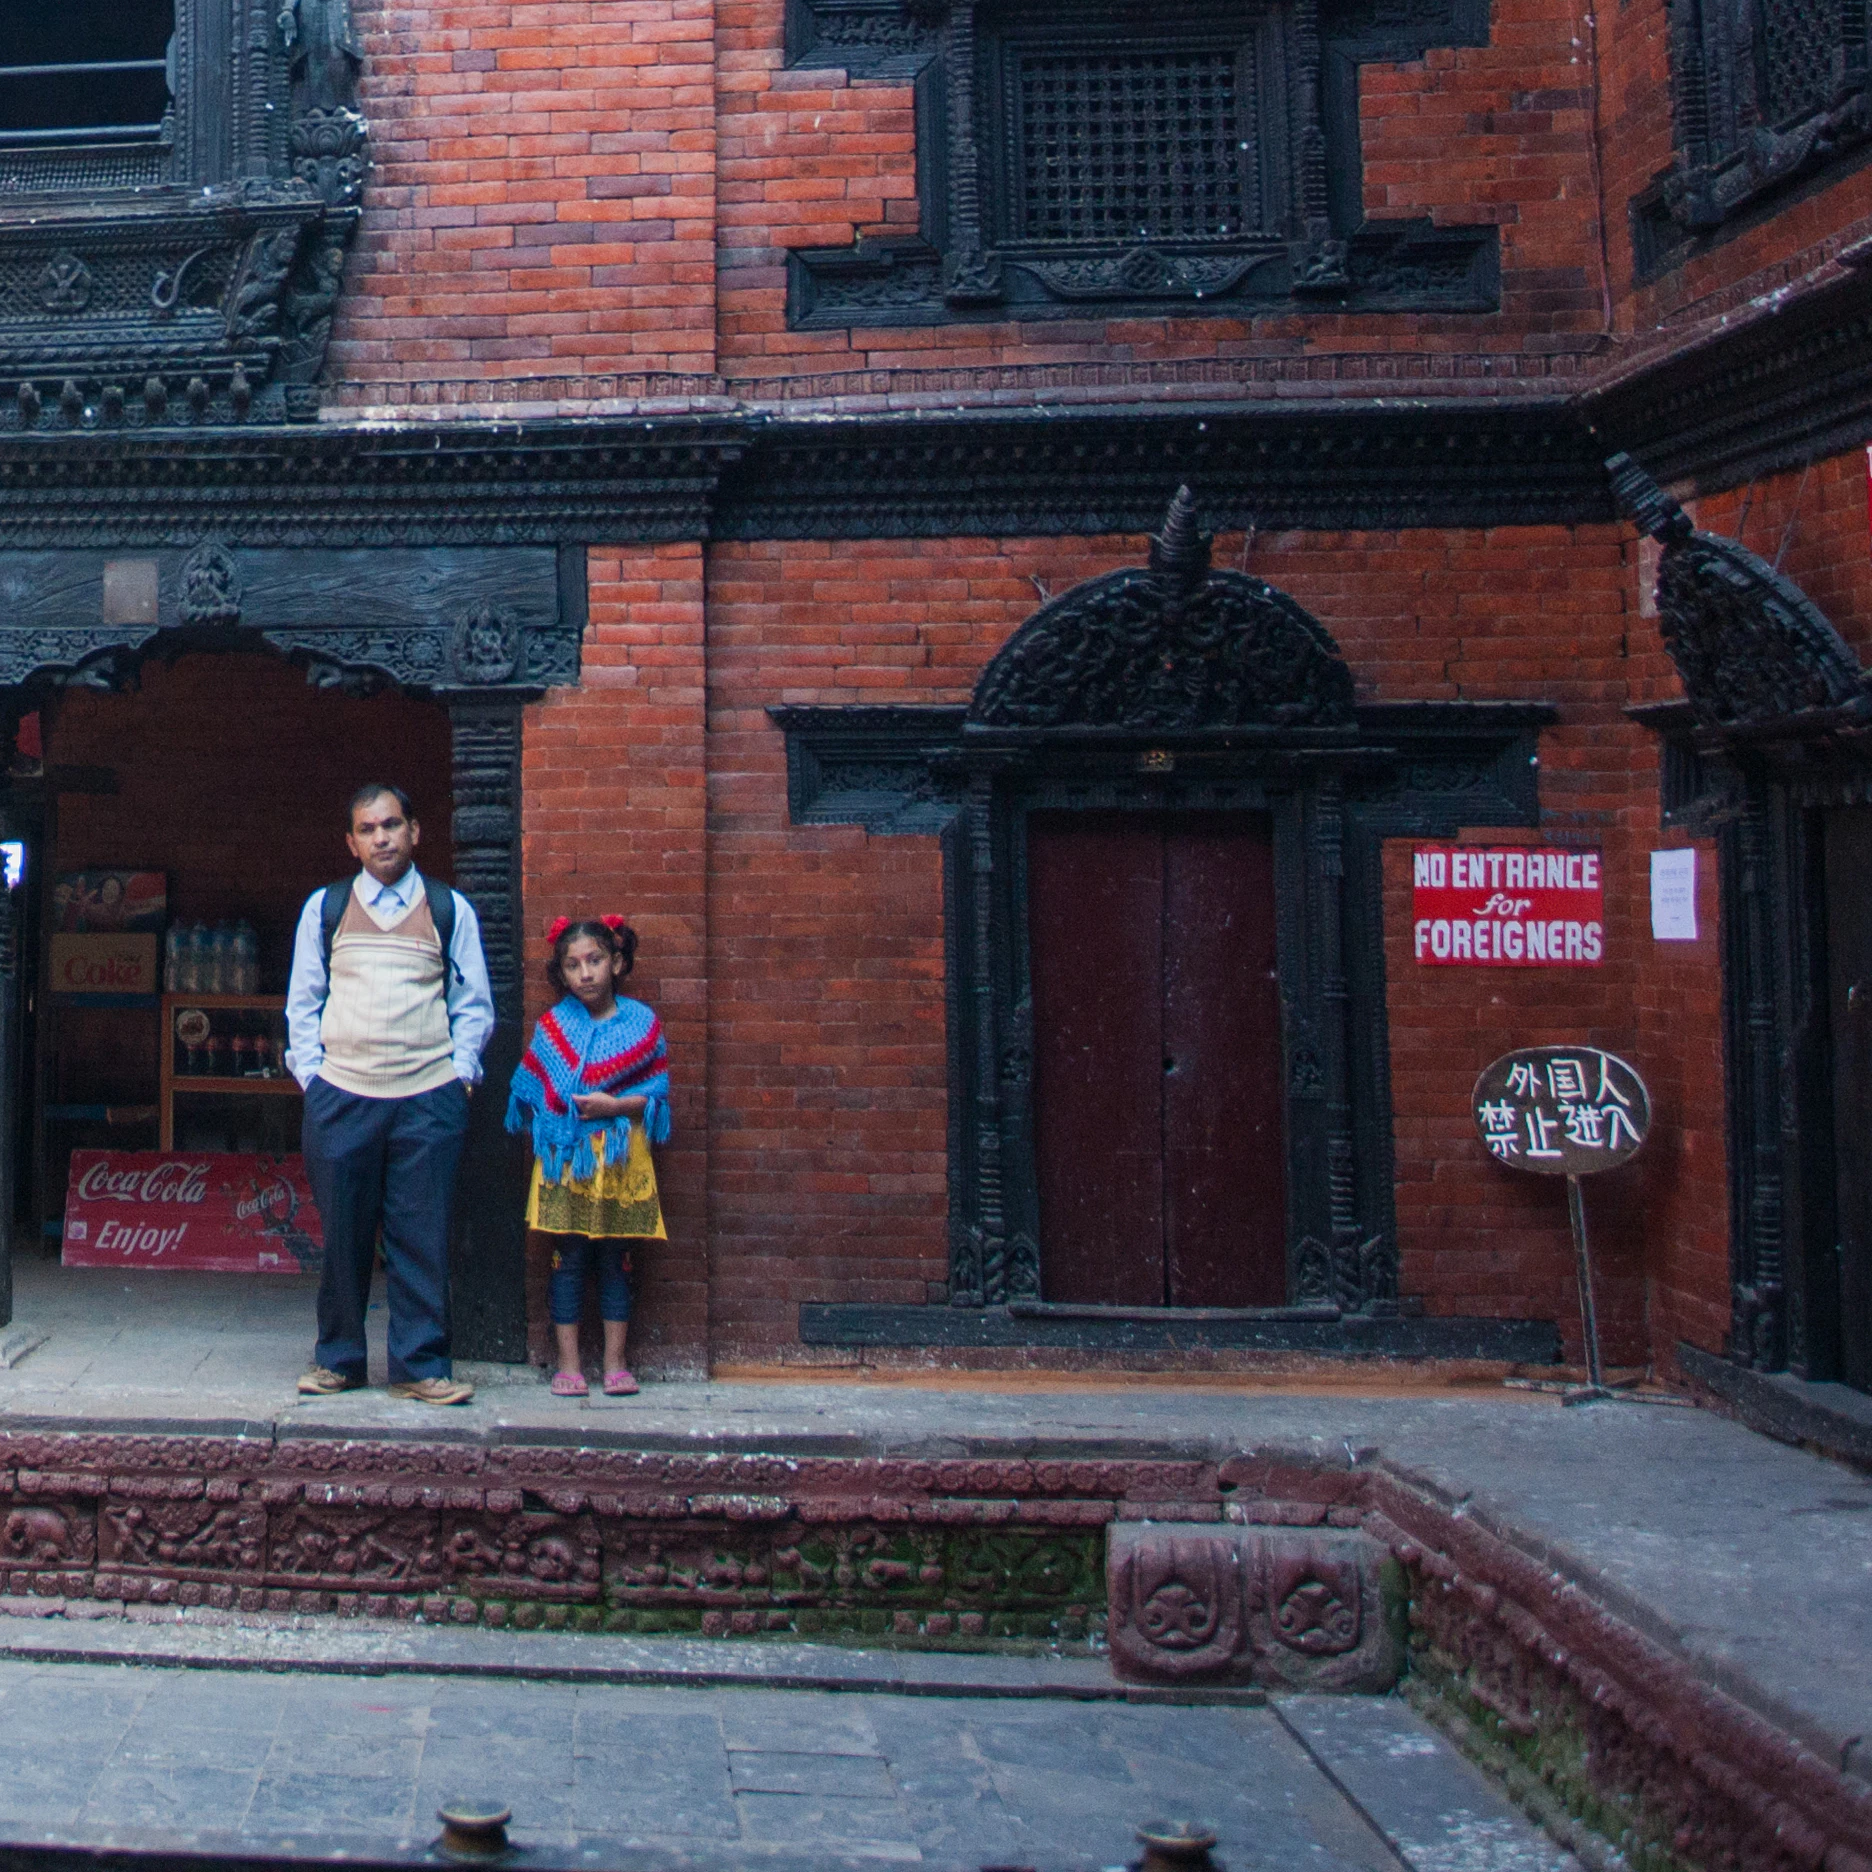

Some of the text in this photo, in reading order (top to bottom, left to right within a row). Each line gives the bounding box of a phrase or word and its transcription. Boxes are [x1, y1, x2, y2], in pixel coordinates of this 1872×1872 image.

[1414, 853, 1599, 889] NO ENTRANCE
[1472, 893, 1531, 916] for
[1414, 919, 1603, 960] FOREIGNERS
[64, 954, 141, 986] Coke
[1504, 1055, 1631, 1106] 外国人
[1478, 1098, 1642, 1159] 禁止进入
[78, 1162, 213, 1203] Coca-Cola
[95, 1221, 188, 1257] Enjoy!
